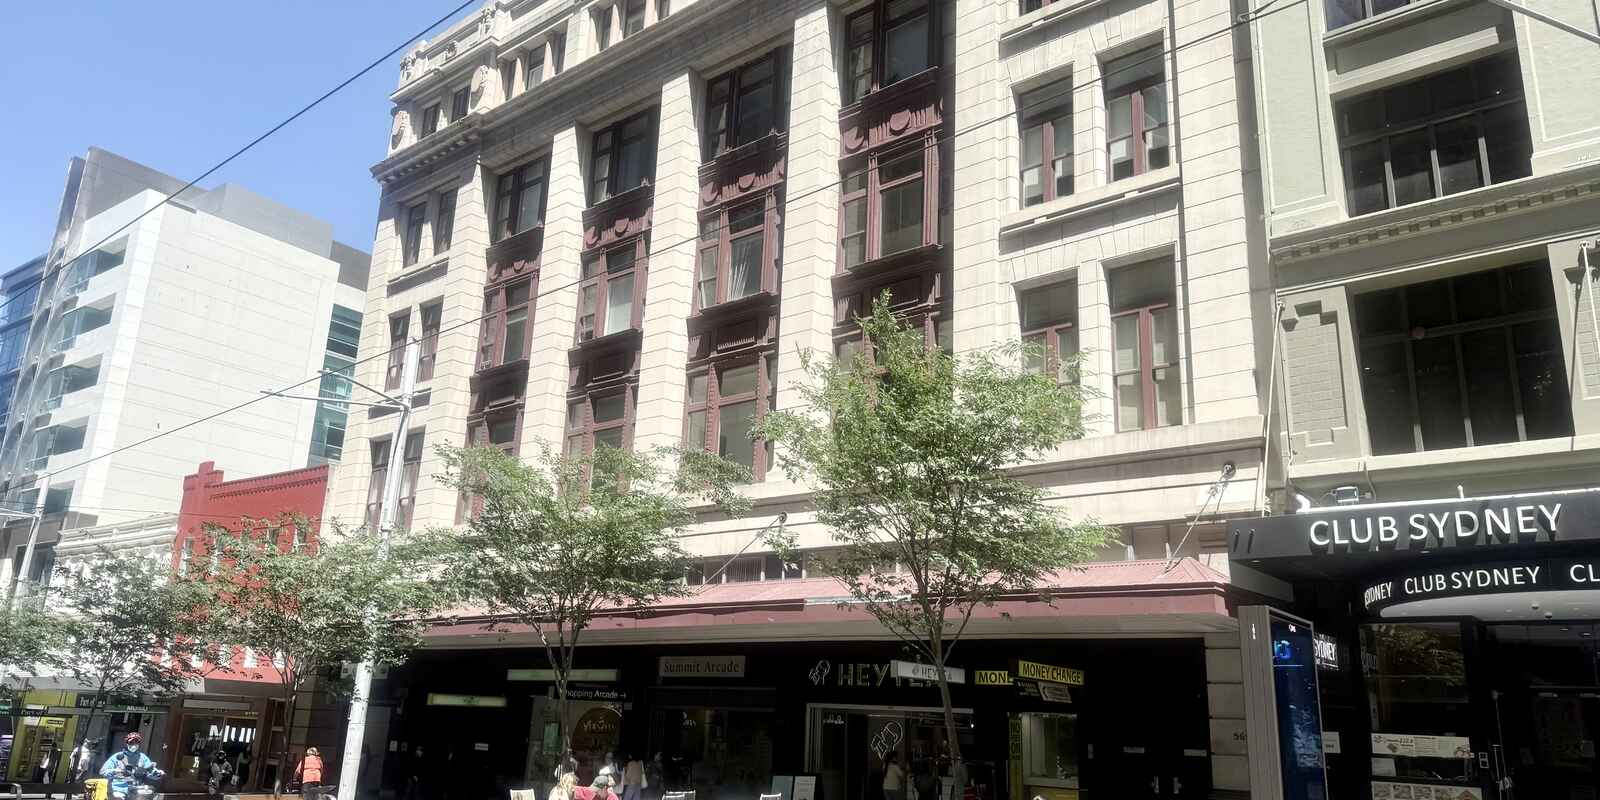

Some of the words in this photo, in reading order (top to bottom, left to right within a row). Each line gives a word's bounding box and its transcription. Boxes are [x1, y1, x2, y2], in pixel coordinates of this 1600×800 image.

[1310, 518, 1399, 546] CLUB
[1408, 503, 1562, 541] SYDNEY
[1404, 573, 1447, 594] CLUB
[1450, 565, 1541, 589] SYDNEY
[663, 662, 700, 673] Summit
[704, 661, 740, 673] Arcade
[1022, 663, 1050, 679] MONEY
[1051, 667, 1081, 684] CHANGE
[560, 687, 593, 698] hopping
[594, 689, 618, 698] Arcade
